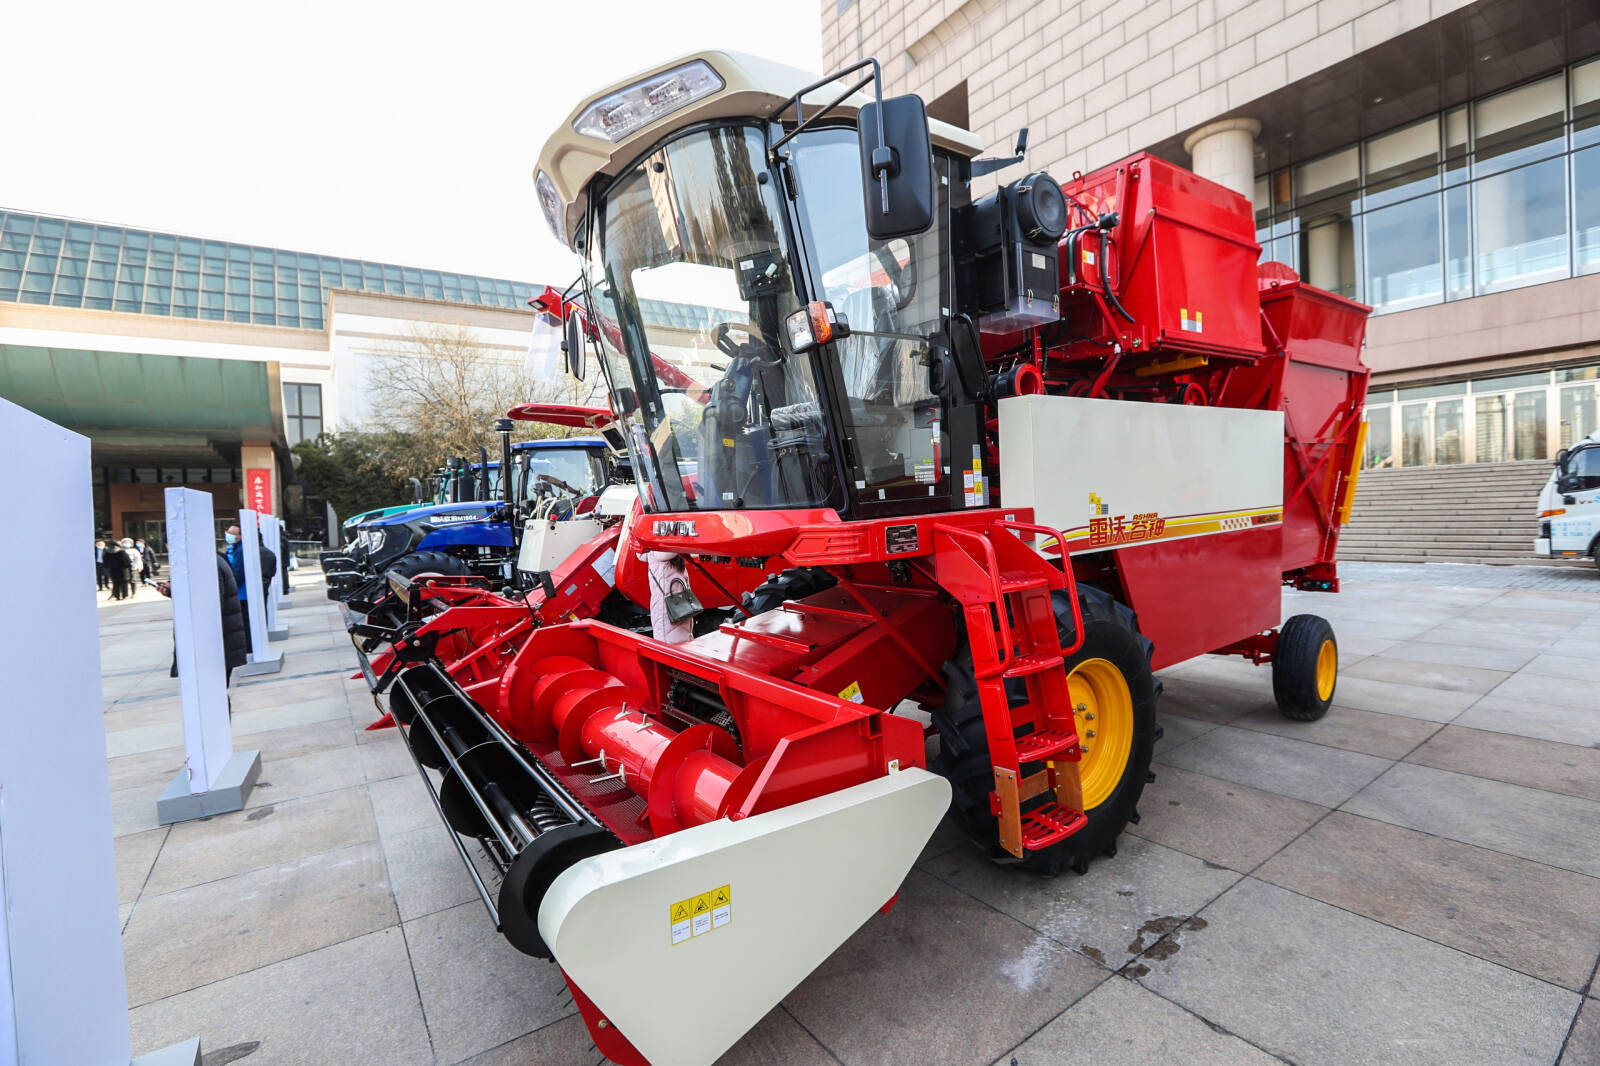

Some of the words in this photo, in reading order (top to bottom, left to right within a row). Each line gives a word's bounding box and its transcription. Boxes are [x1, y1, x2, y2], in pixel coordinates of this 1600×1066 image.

[653, 520, 699, 536] LOVOL
[1089, 515, 1165, 546] 雷沃谷神
